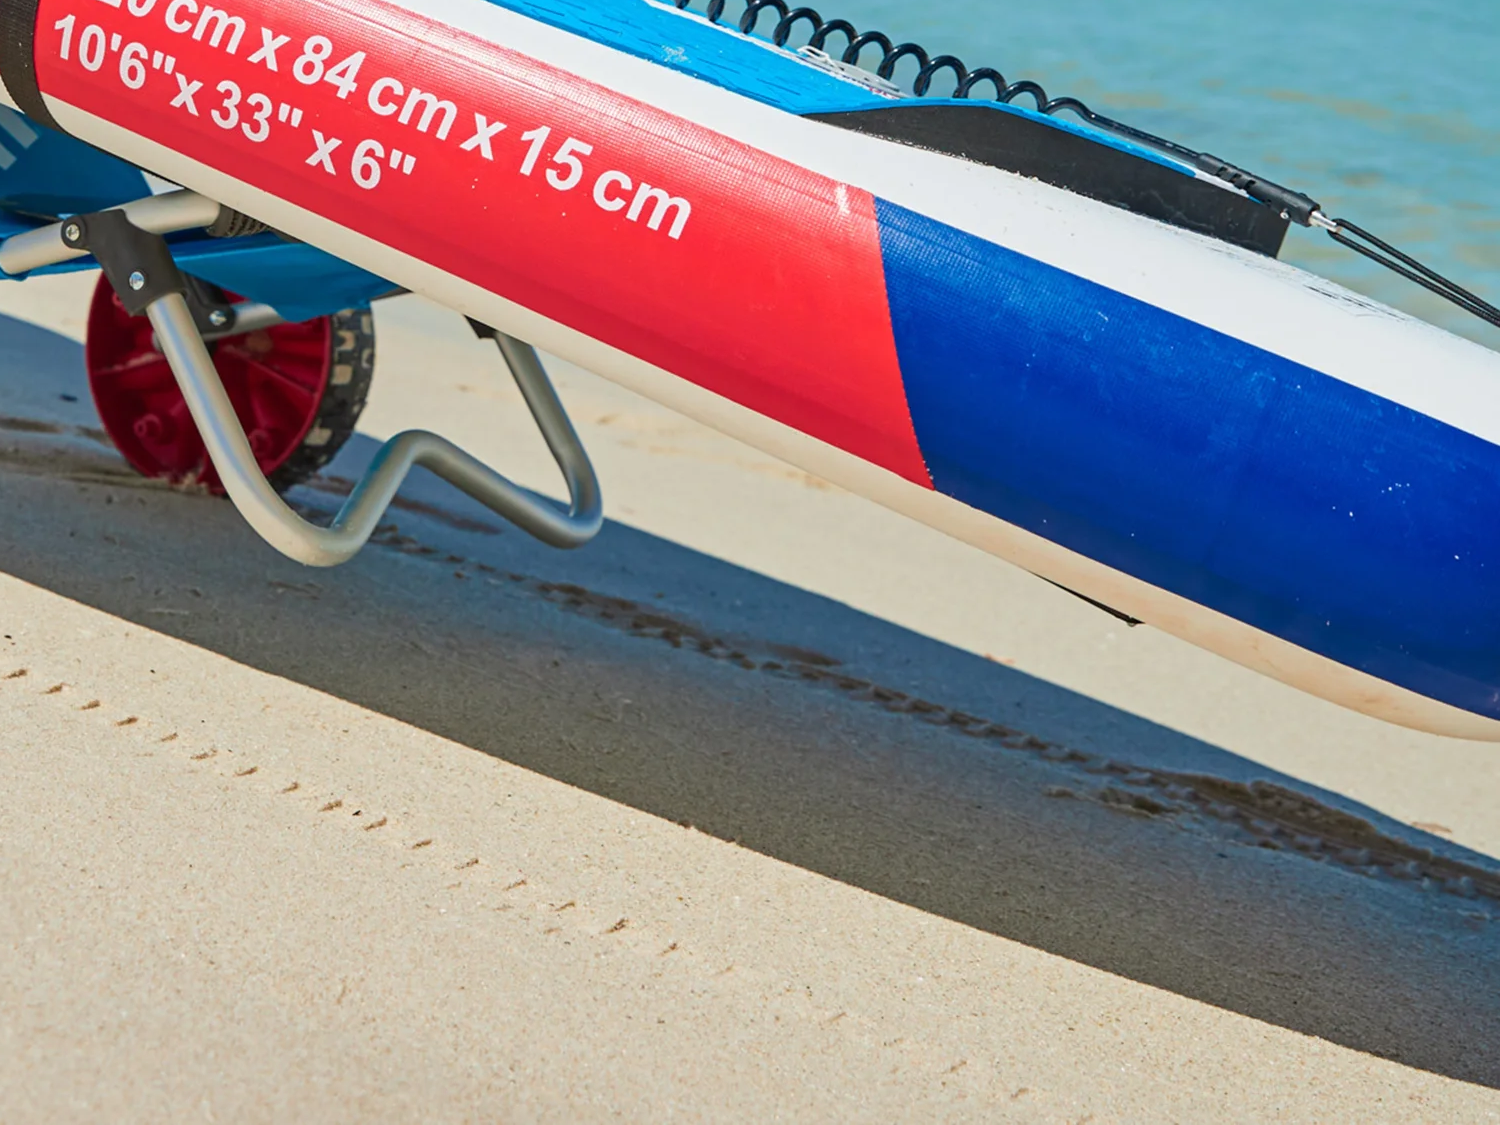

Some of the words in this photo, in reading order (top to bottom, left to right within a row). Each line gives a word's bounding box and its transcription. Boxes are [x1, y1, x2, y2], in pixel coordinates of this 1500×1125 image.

[210, 79, 304, 143] 33"
[305, 128, 343, 175] x
[350, 137, 417, 190] 6"
[247, 26, 292, 73] x
[292, 33, 368, 100] 84
[366, 75, 458, 142] cm
[460, 111, 508, 161] x
[518, 124, 595, 192] 15
[591, 168, 693, 241] cm
